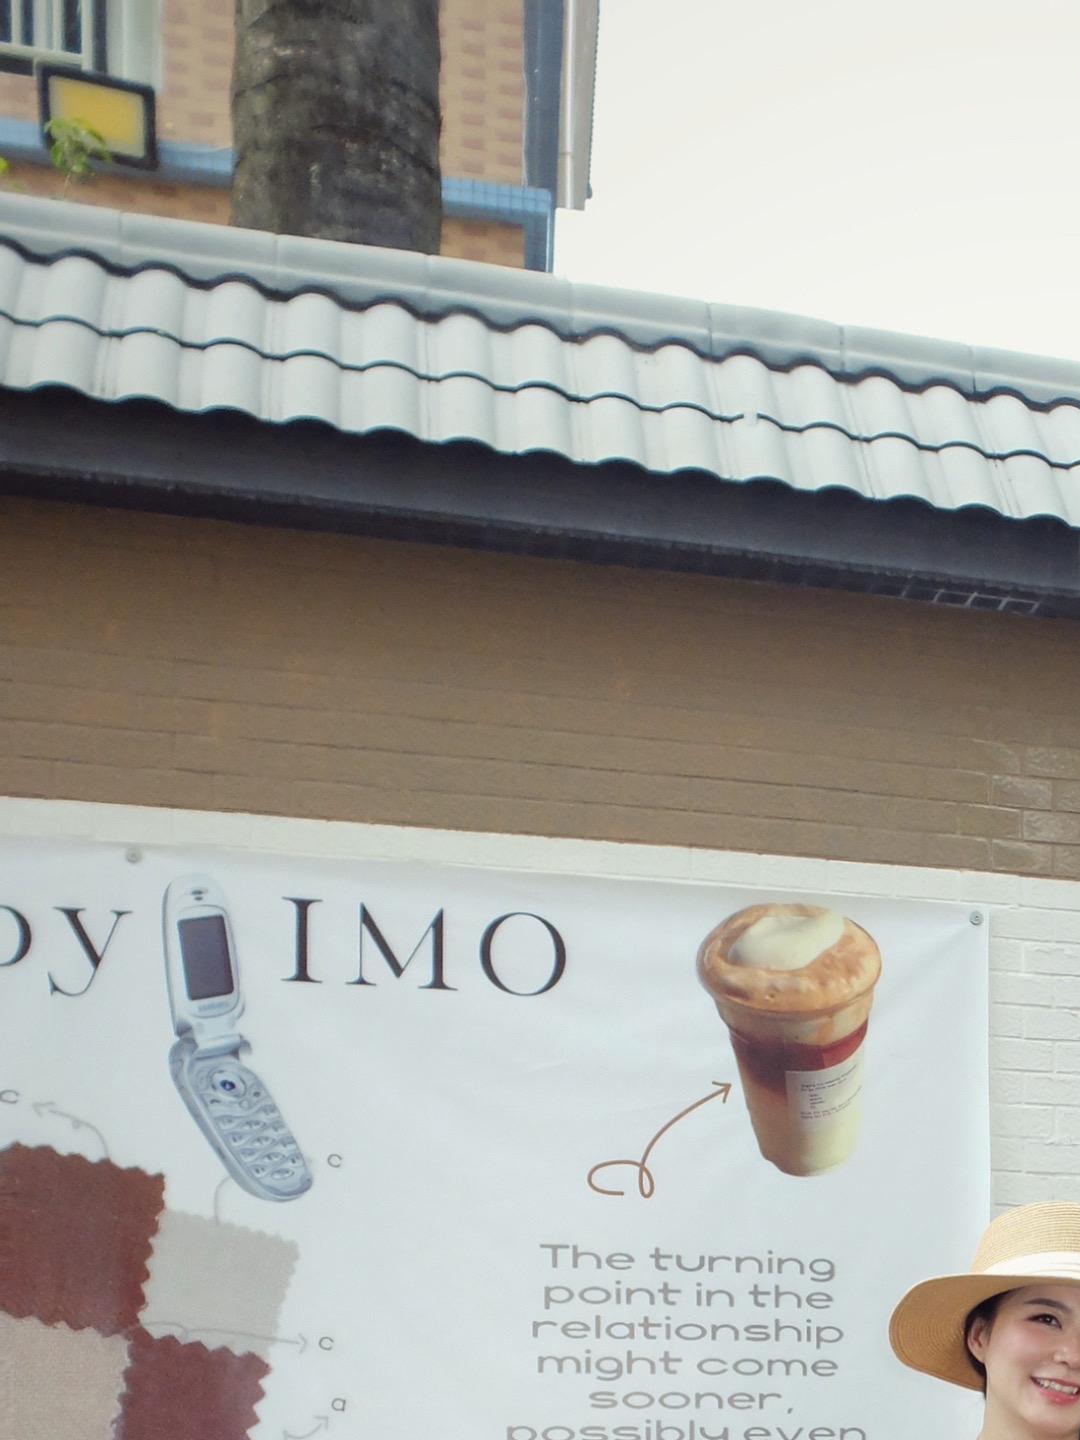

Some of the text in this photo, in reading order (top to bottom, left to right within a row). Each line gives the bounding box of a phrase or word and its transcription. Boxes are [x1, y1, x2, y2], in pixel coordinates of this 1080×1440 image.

[281, 895, 568, 997] IMO
[539, 1243, 836, 1283] The turning
[543, 1280, 834, 1310] point in the
[531, 1314, 844, 1350] relationship
[537, 1349, 839, 1381] might come
[588, 1390, 794, 1415] sooner,
